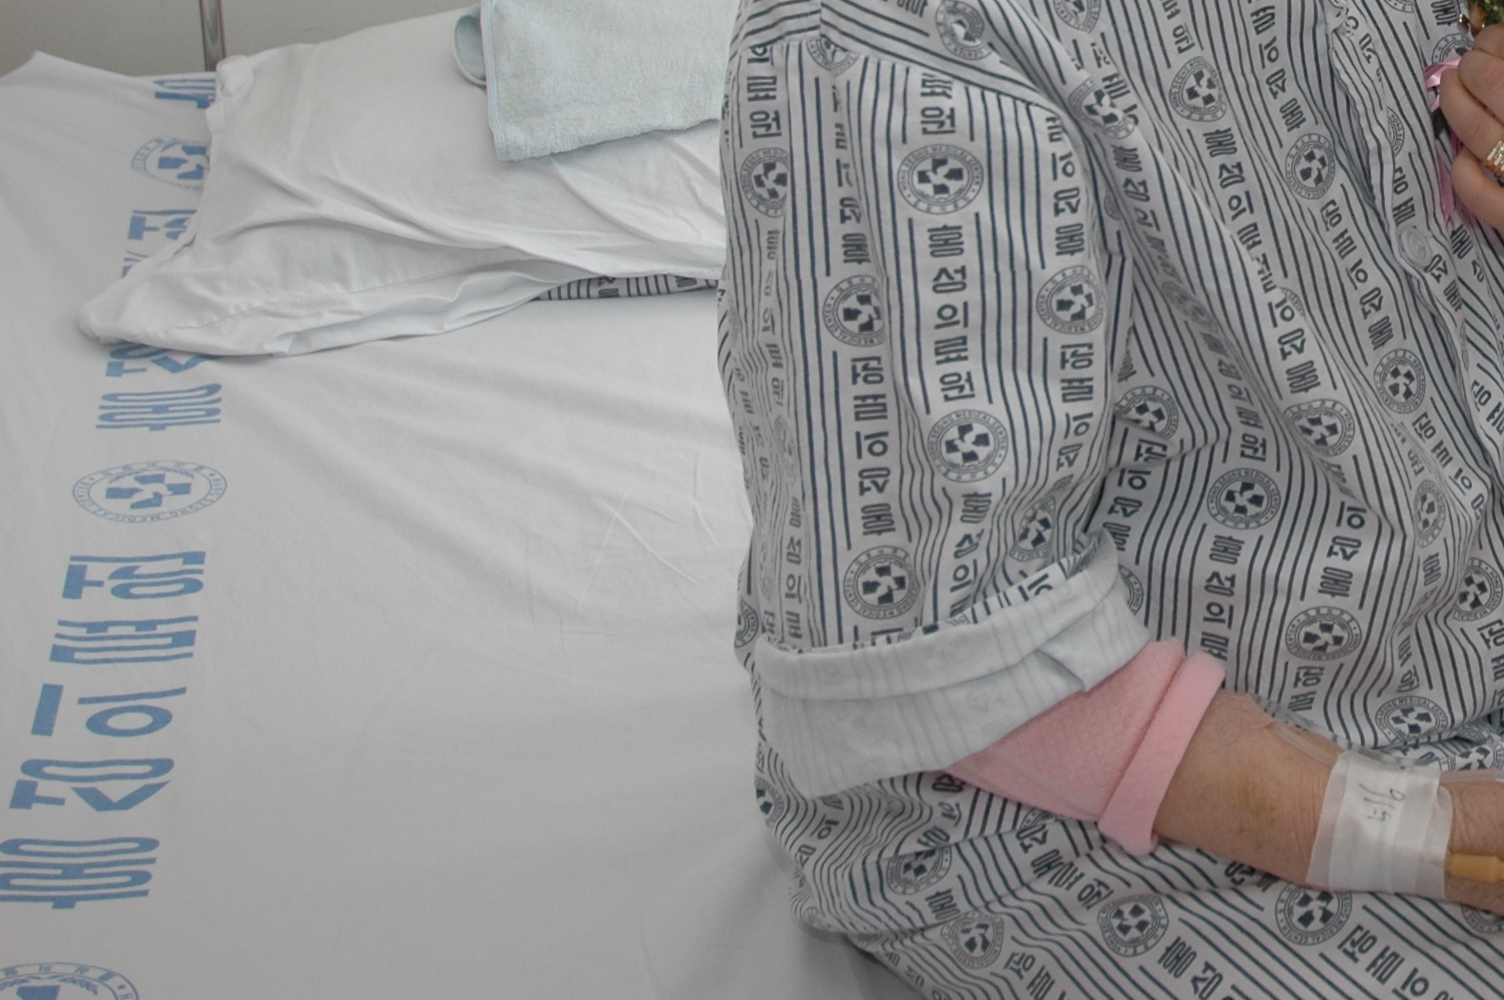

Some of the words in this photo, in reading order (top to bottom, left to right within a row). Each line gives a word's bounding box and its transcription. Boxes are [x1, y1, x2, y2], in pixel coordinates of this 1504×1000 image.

[928, 224, 977, 403] 홍성의료원
[1320, 199, 1394, 350] 홍성의료원
[851, 356, 896, 537] 홍성의료원
[0, 551, 207, 910] 홍성의료원
